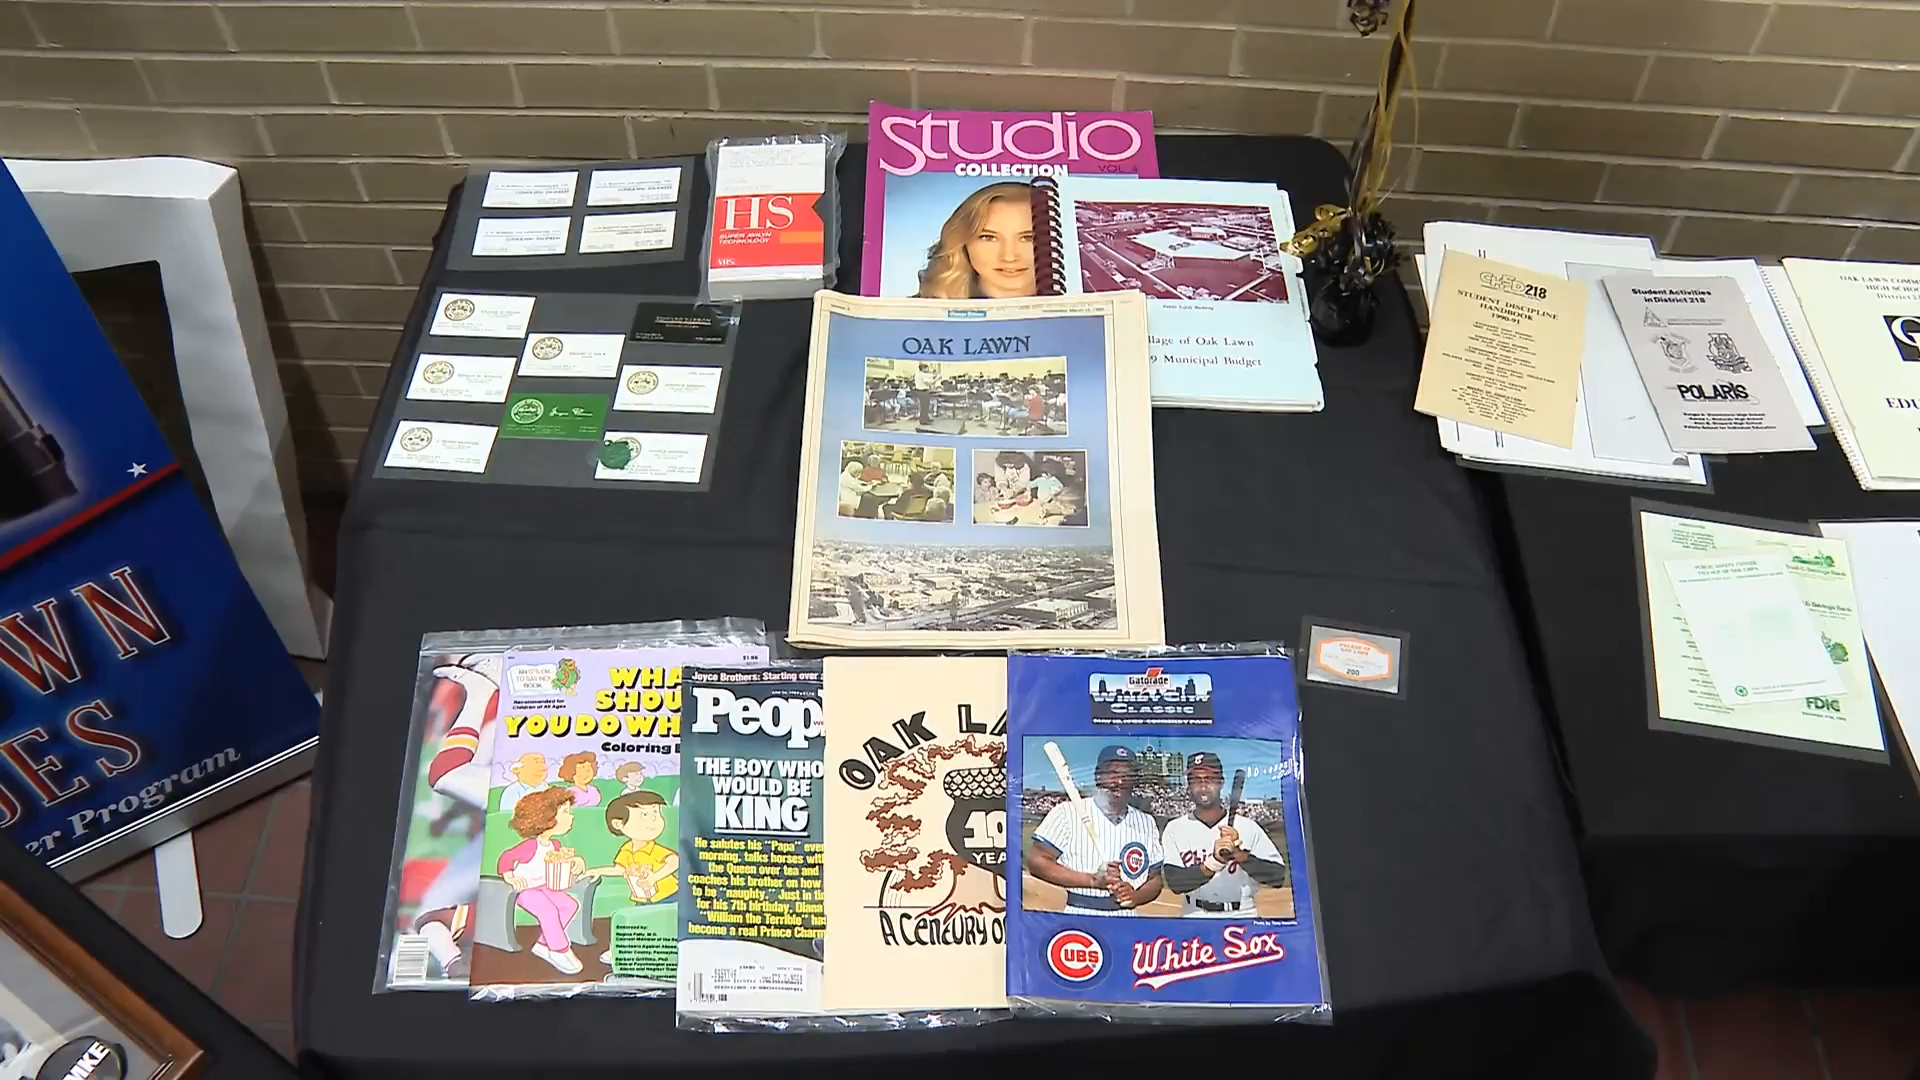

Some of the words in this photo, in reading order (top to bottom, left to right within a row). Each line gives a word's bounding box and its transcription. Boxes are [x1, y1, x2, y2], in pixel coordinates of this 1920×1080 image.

[879, 111, 1142, 177] Studio
[954, 162, 1069, 177] COLLECTION
[719, 194, 795, 231] HS
[1524, 283, 1547, 299] 218
[1631, 288, 1668, 296] Student
[1668, 288, 1712, 296] Activities
[1457, 289, 1500, 305] STUDENT
[1505, 301, 1559, 320] DISCIPLINE
[1653, 296, 1689, 304] District
[1480, 302, 1534, 321] HANDBOOK
[902, 335, 954, 355] OAK
[963, 335, 1032, 355] LAWN
[1179, 335, 1191, 345] of
[1195, 336, 1219, 346] Oak
[1223, 337, 1254, 347] Lawn
[1164, 355, 1219, 367] Municipal
[1223, 356, 1263, 368] Budget
[1676, 383, 1750, 400] POLARIS
[691, 671, 719, 683] Joyce
[720, 672, 761, 682] Brothers:
[762, 671, 797, 682] Starting
[798, 672, 819, 681] over
[1128, 676, 1169, 686] Gatorade
[1806, 696, 1841, 712] FDIC
[503, 714, 571, 737] YOU
[575, 714, 622, 737] DO
[601, 741, 671, 755] Coloring
[838, 711, 937, 790] OAK
[693, 756, 731, 776] THE
[733, 757, 775, 778] BOY
[776, 759, 824, 779] WHO
[67, 746, 242, 840] Program
[711, 776, 784, 797] WOULD
[786, 778, 812, 798] BE
[714, 794, 810, 832] KING
[695, 837, 708, 849] He
[709, 838, 746, 850] salutes
[747, 839, 763, 850] his
[743, 852, 769, 863] talks
[770, 853, 804, 864] horses
[708, 862, 724, 873] the
[726, 862, 757, 875] Queen
[758, 865, 781, 875] over
[783, 865, 799, 876] tea
[801, 865, 820, 876] and
[687, 874, 729, 886] coaches
[730, 874, 746, 886] his
[747, 875, 784, 888] brother
[786, 879, 799, 888] on
[800, 877, 821, 888] how
[692, 885, 703, 896] to
[704, 886, 717, 897] be
[778, 889, 801, 900] Just
[802, 889, 812, 900] in
[696, 897, 712, 909] for
[712, 898, 729, 910] his
[731, 899, 747, 911] 7th
[745, 913, 762, 924] the
[687, 922, 727, 935] become
[729, 927, 736, 935] a
[738, 925, 758, 936] real
[759, 926, 792, 937] Prince
[879, 910, 900, 946] A
[1132, 936, 1217, 976] White
[1223, 925, 1284, 960] Sox
